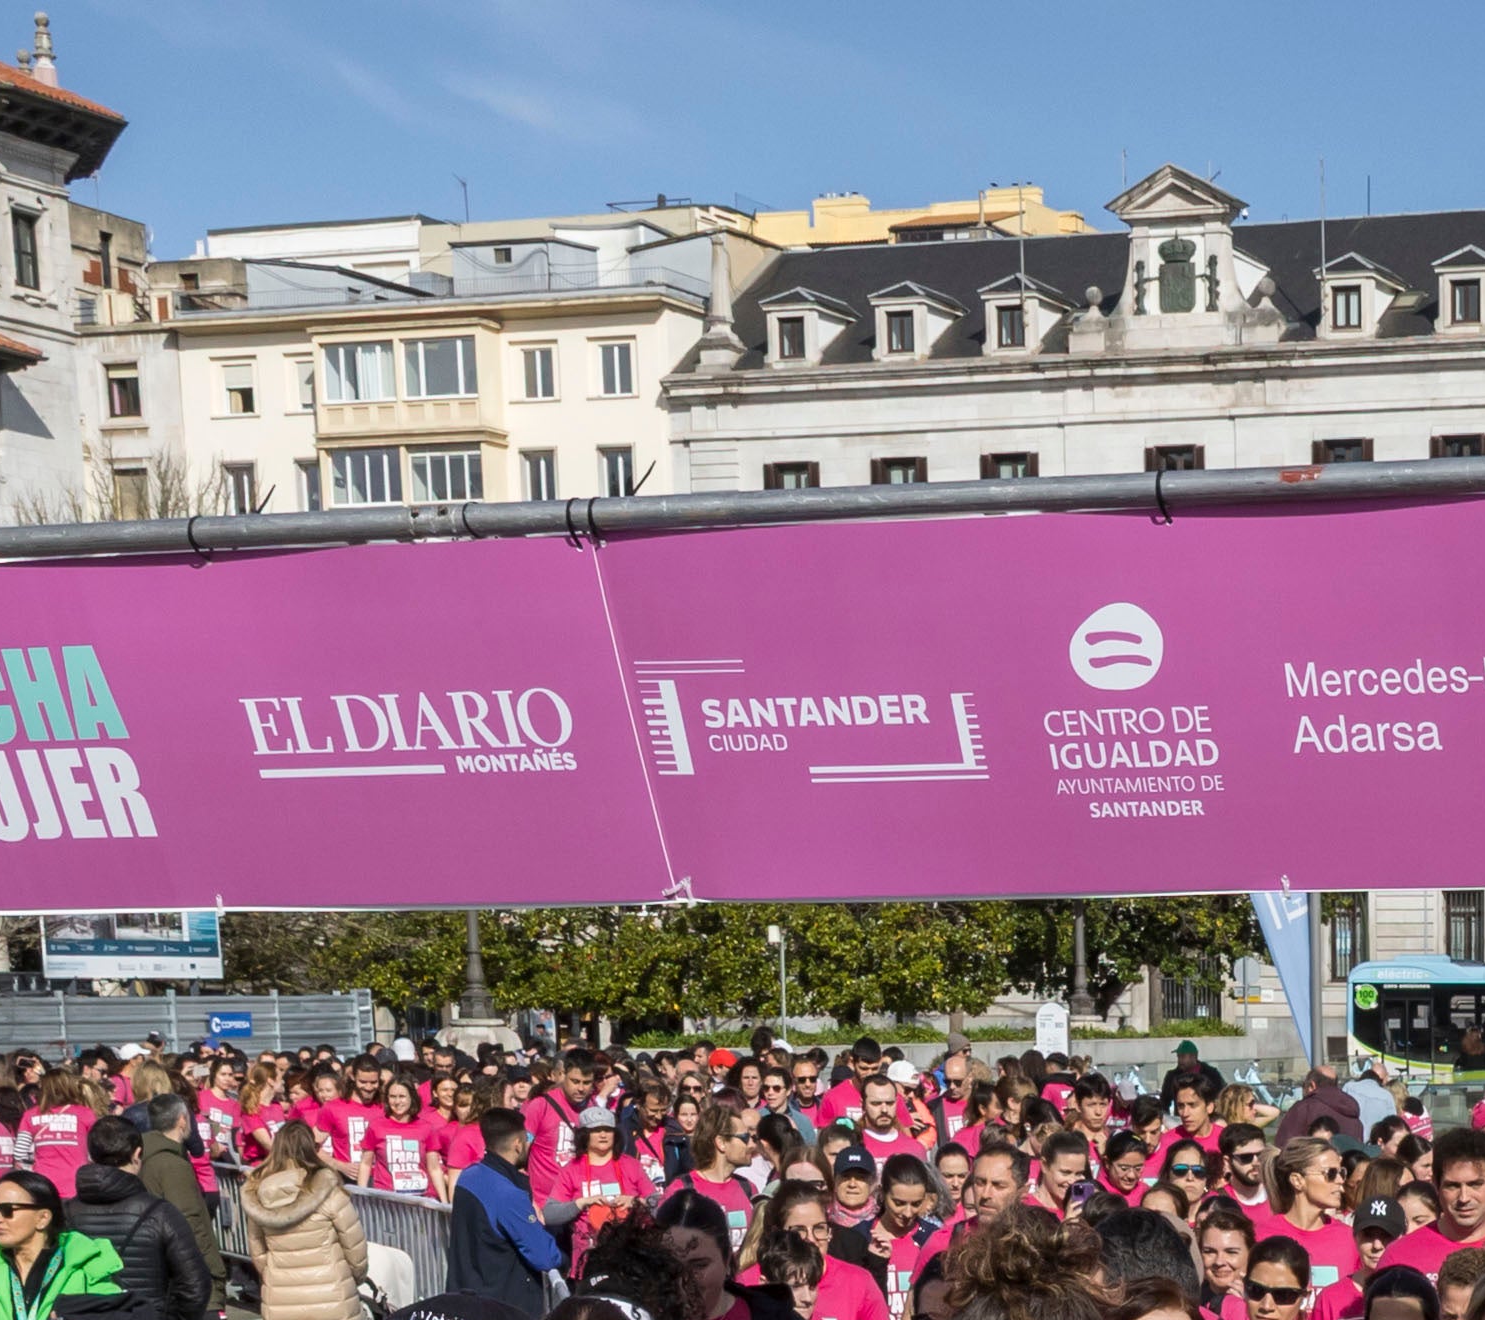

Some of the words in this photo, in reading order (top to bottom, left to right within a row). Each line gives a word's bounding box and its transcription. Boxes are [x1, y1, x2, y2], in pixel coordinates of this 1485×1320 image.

[239, 697, 333, 756] EL
[331, 687, 575, 753] DIARIO
[700, 694, 930, 728] SANTANDER
[1043, 707, 1164, 737] CENTRO
[1172, 705, 1212, 734] DE
[708, 734, 788, 753] CIUDAD
[1293, 716, 1442, 754] Adarsa
[455, 748, 577, 774] MONTAÑÉS
[1049, 739, 1220, 770] IGUALDAD
[1056, 776, 1197, 796] AYUNTAMIENTO
[1200, 775, 1225, 792] DE
[1090, 799, 1205, 818] SANTANDER
